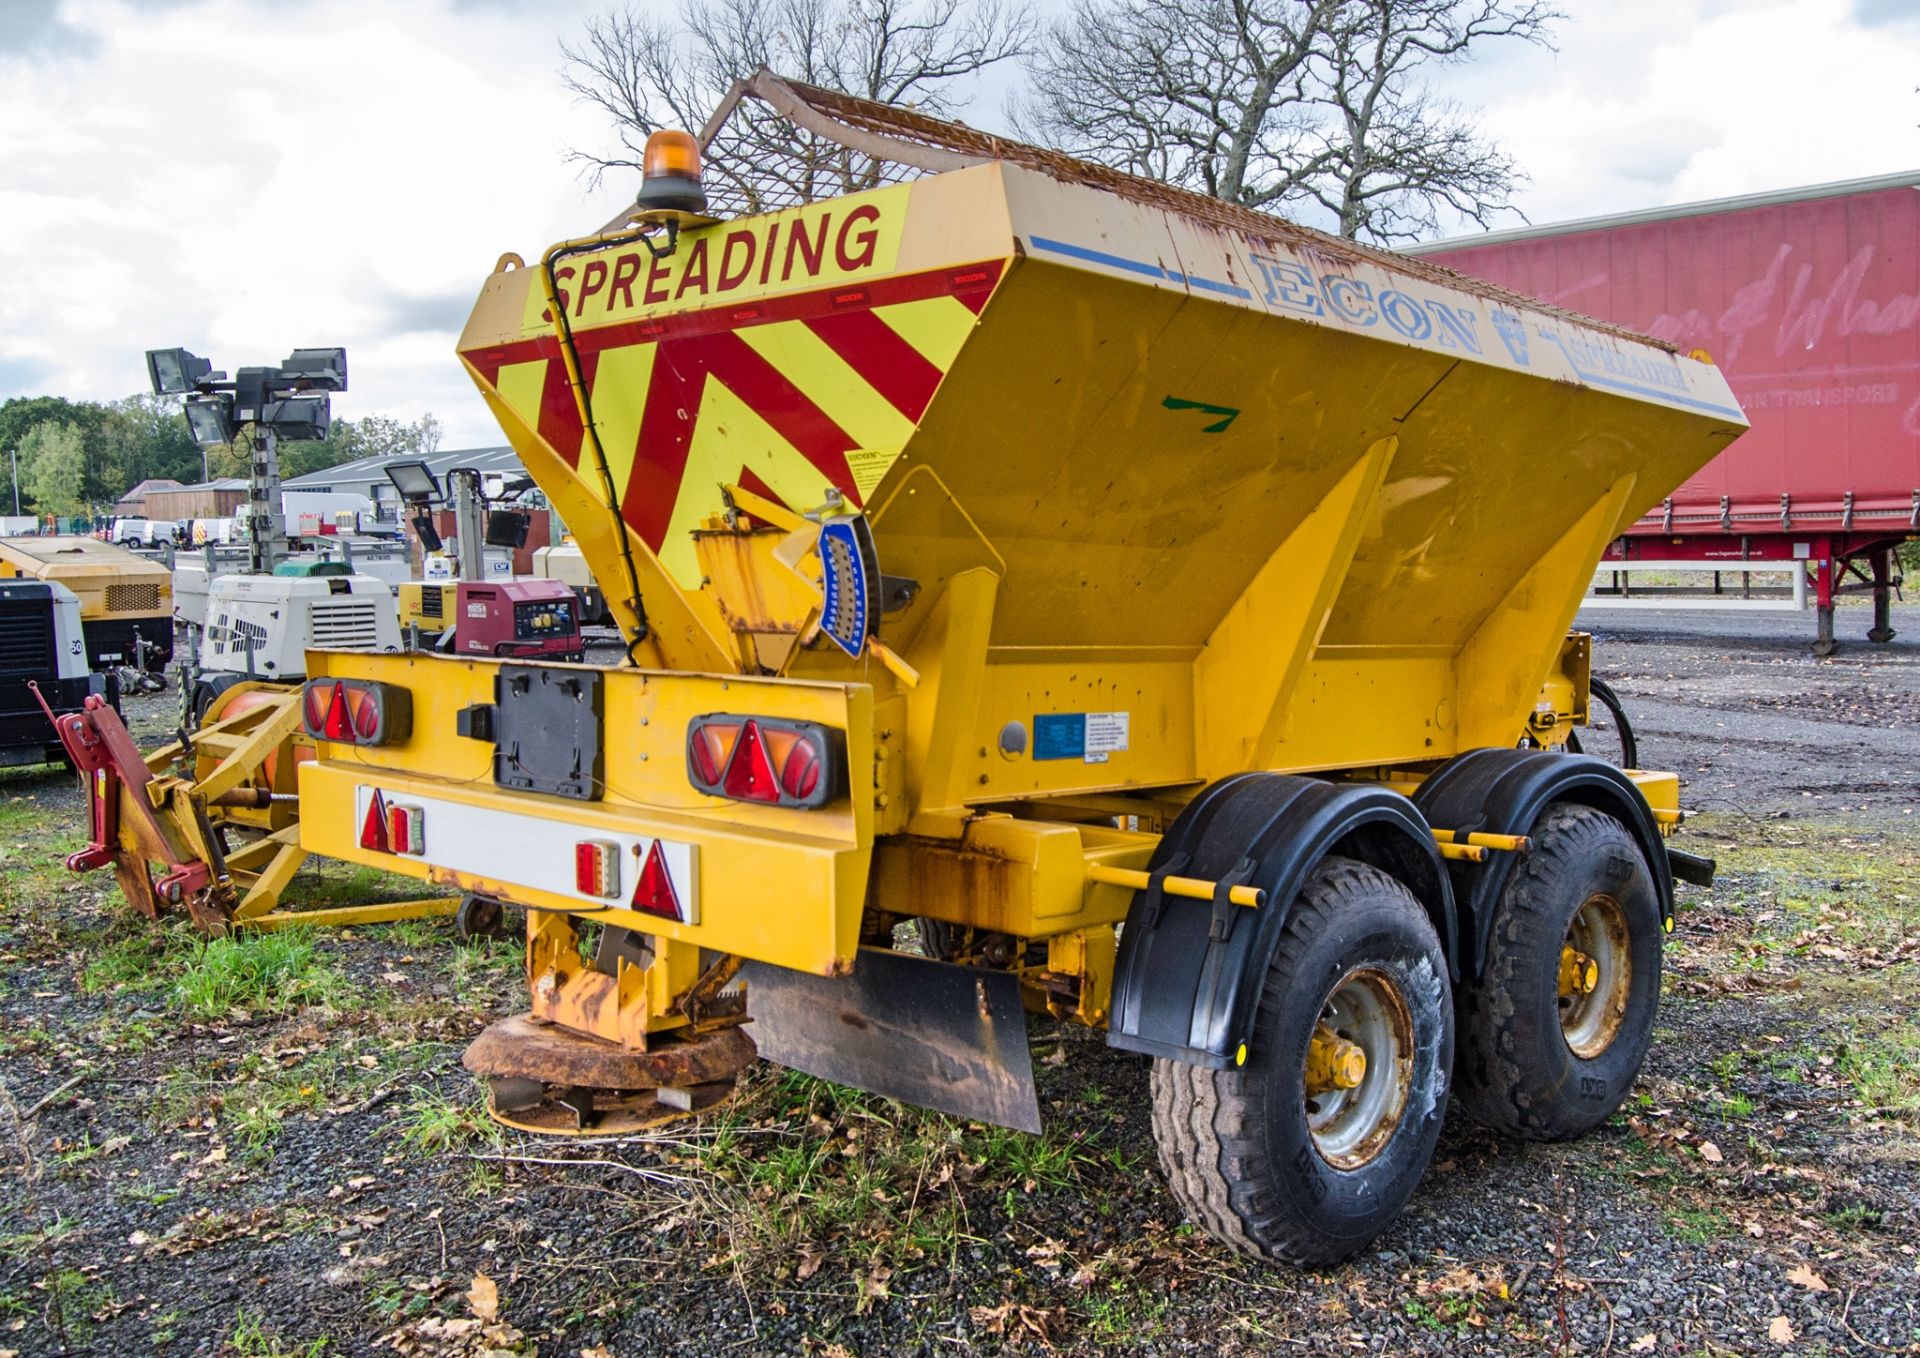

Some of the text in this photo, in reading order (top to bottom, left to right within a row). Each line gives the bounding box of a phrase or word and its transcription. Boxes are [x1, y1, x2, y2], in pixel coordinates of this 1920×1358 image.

[542, 204, 881, 322] SPREADING
[1249, 253, 1484, 355] ECON
[1568, 335, 1690, 392] SPREADER
[1581, 1076, 1607, 1101] BKT
